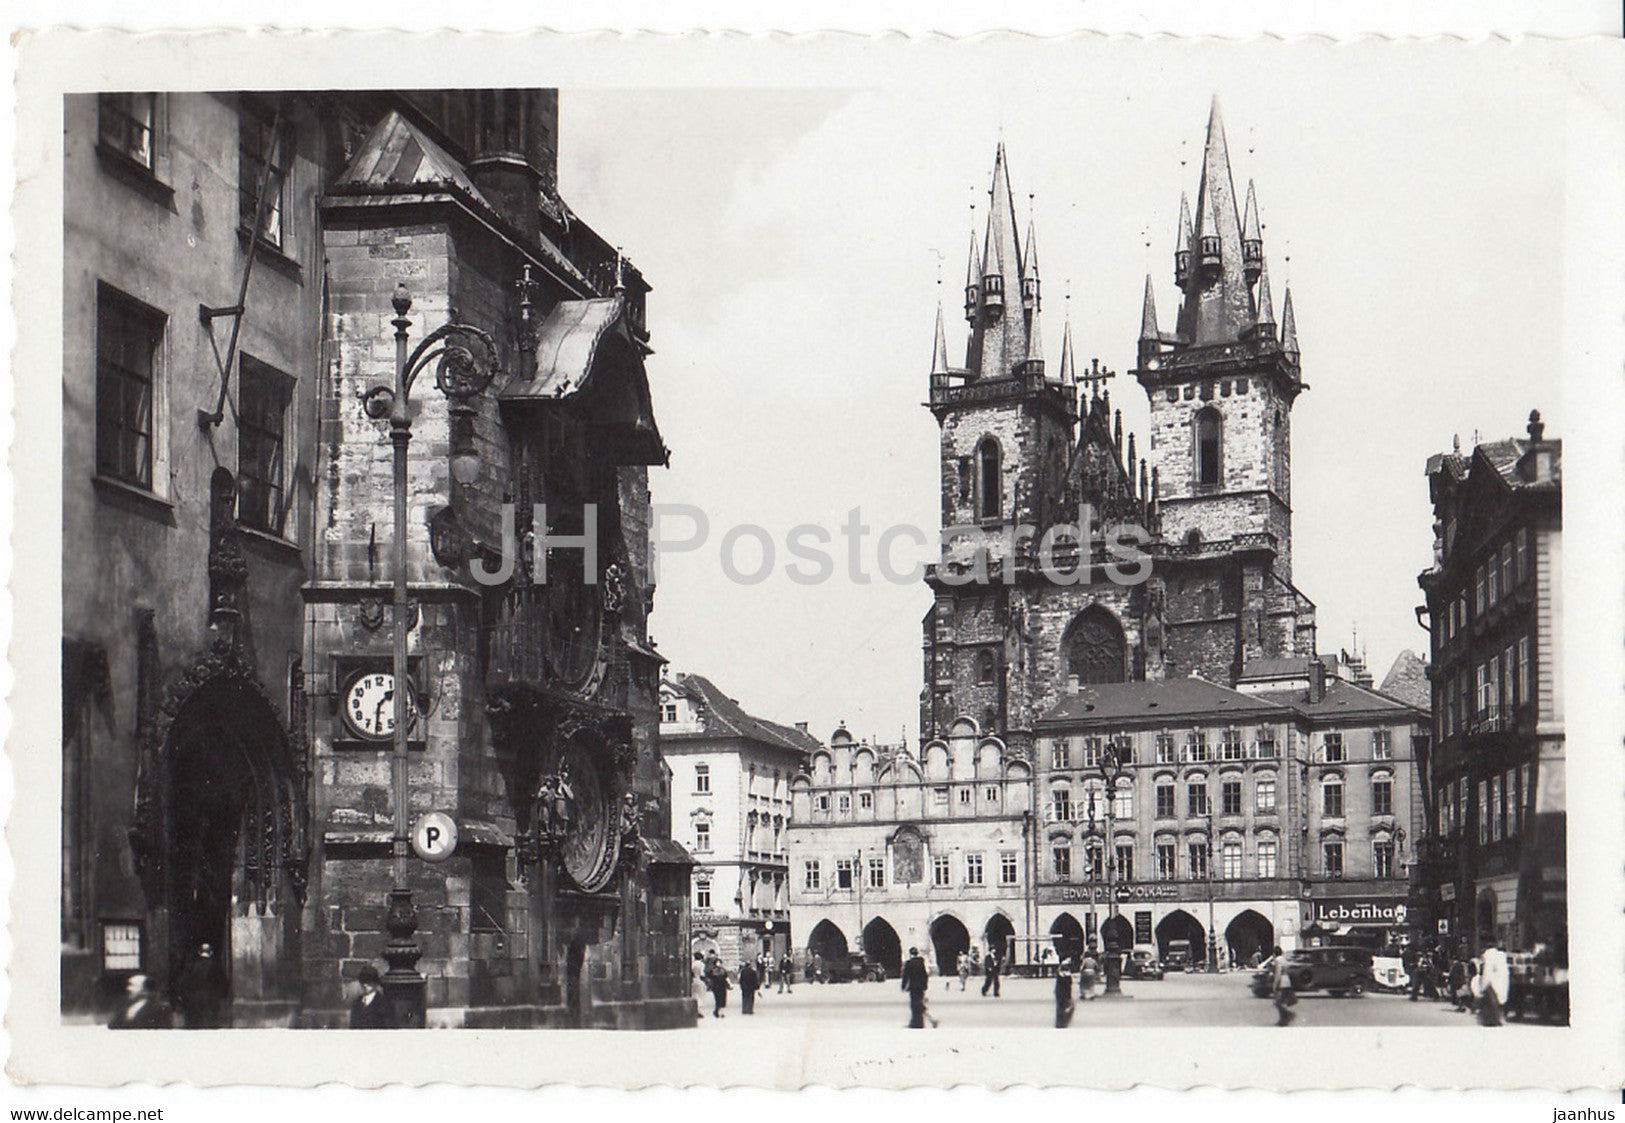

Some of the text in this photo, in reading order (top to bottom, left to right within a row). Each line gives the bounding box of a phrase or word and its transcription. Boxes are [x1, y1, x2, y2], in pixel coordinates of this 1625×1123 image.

[364, 679, 371, 690] 11
[375, 676, 384, 687] 12
[354, 687, 364, 698] 10
[352, 699, 360, 709] 9
[355, 711, 363, 721] 8
[365, 718, 371, 729] 7
[387, 718, 395, 729] 5
[426, 827, 440, 848] P
[1063, 887, 1103, 899] EDVAD
